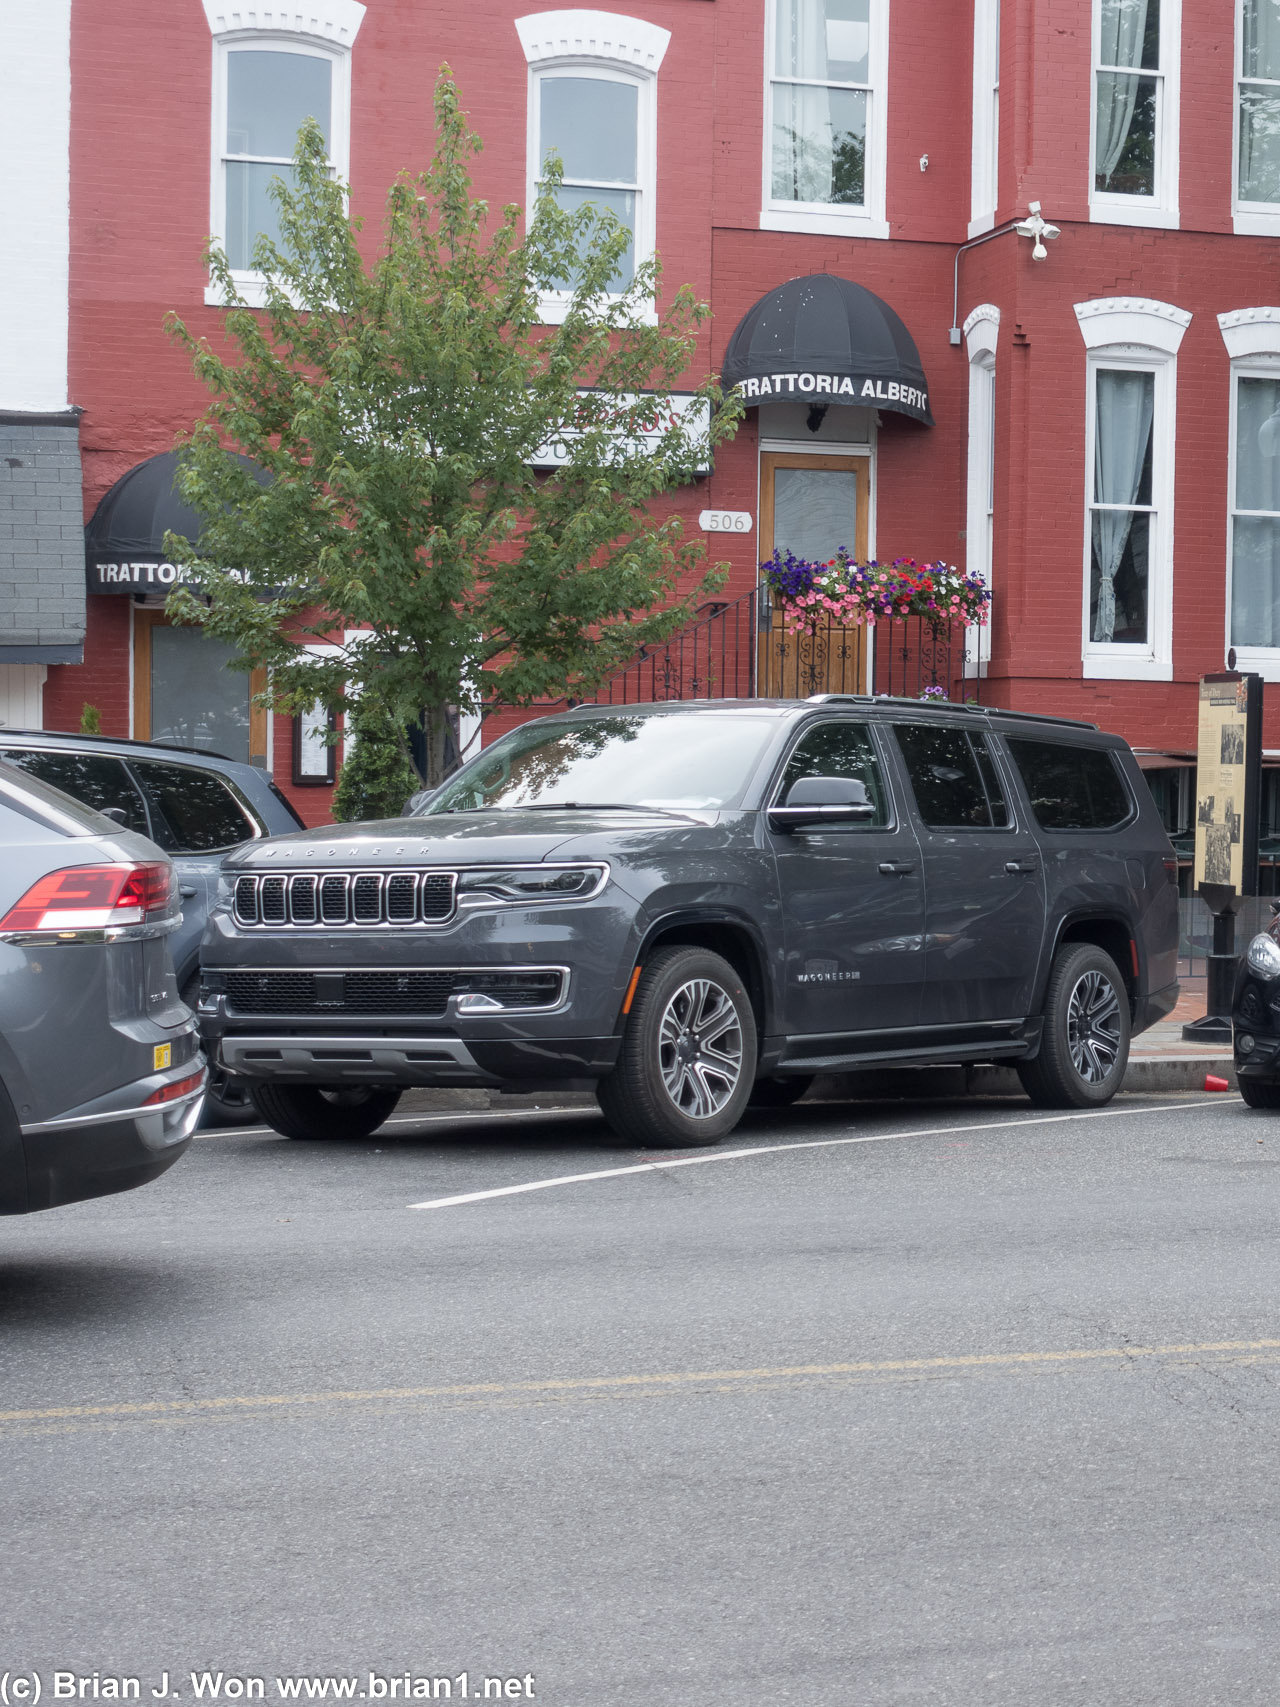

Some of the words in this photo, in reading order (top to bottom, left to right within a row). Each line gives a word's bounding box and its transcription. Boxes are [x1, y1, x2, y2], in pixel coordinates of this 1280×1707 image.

[710, 514, 744, 531] 506
[265, 846, 430, 858] WAGONEER
[797, 972, 851, 983] WAGONEER
